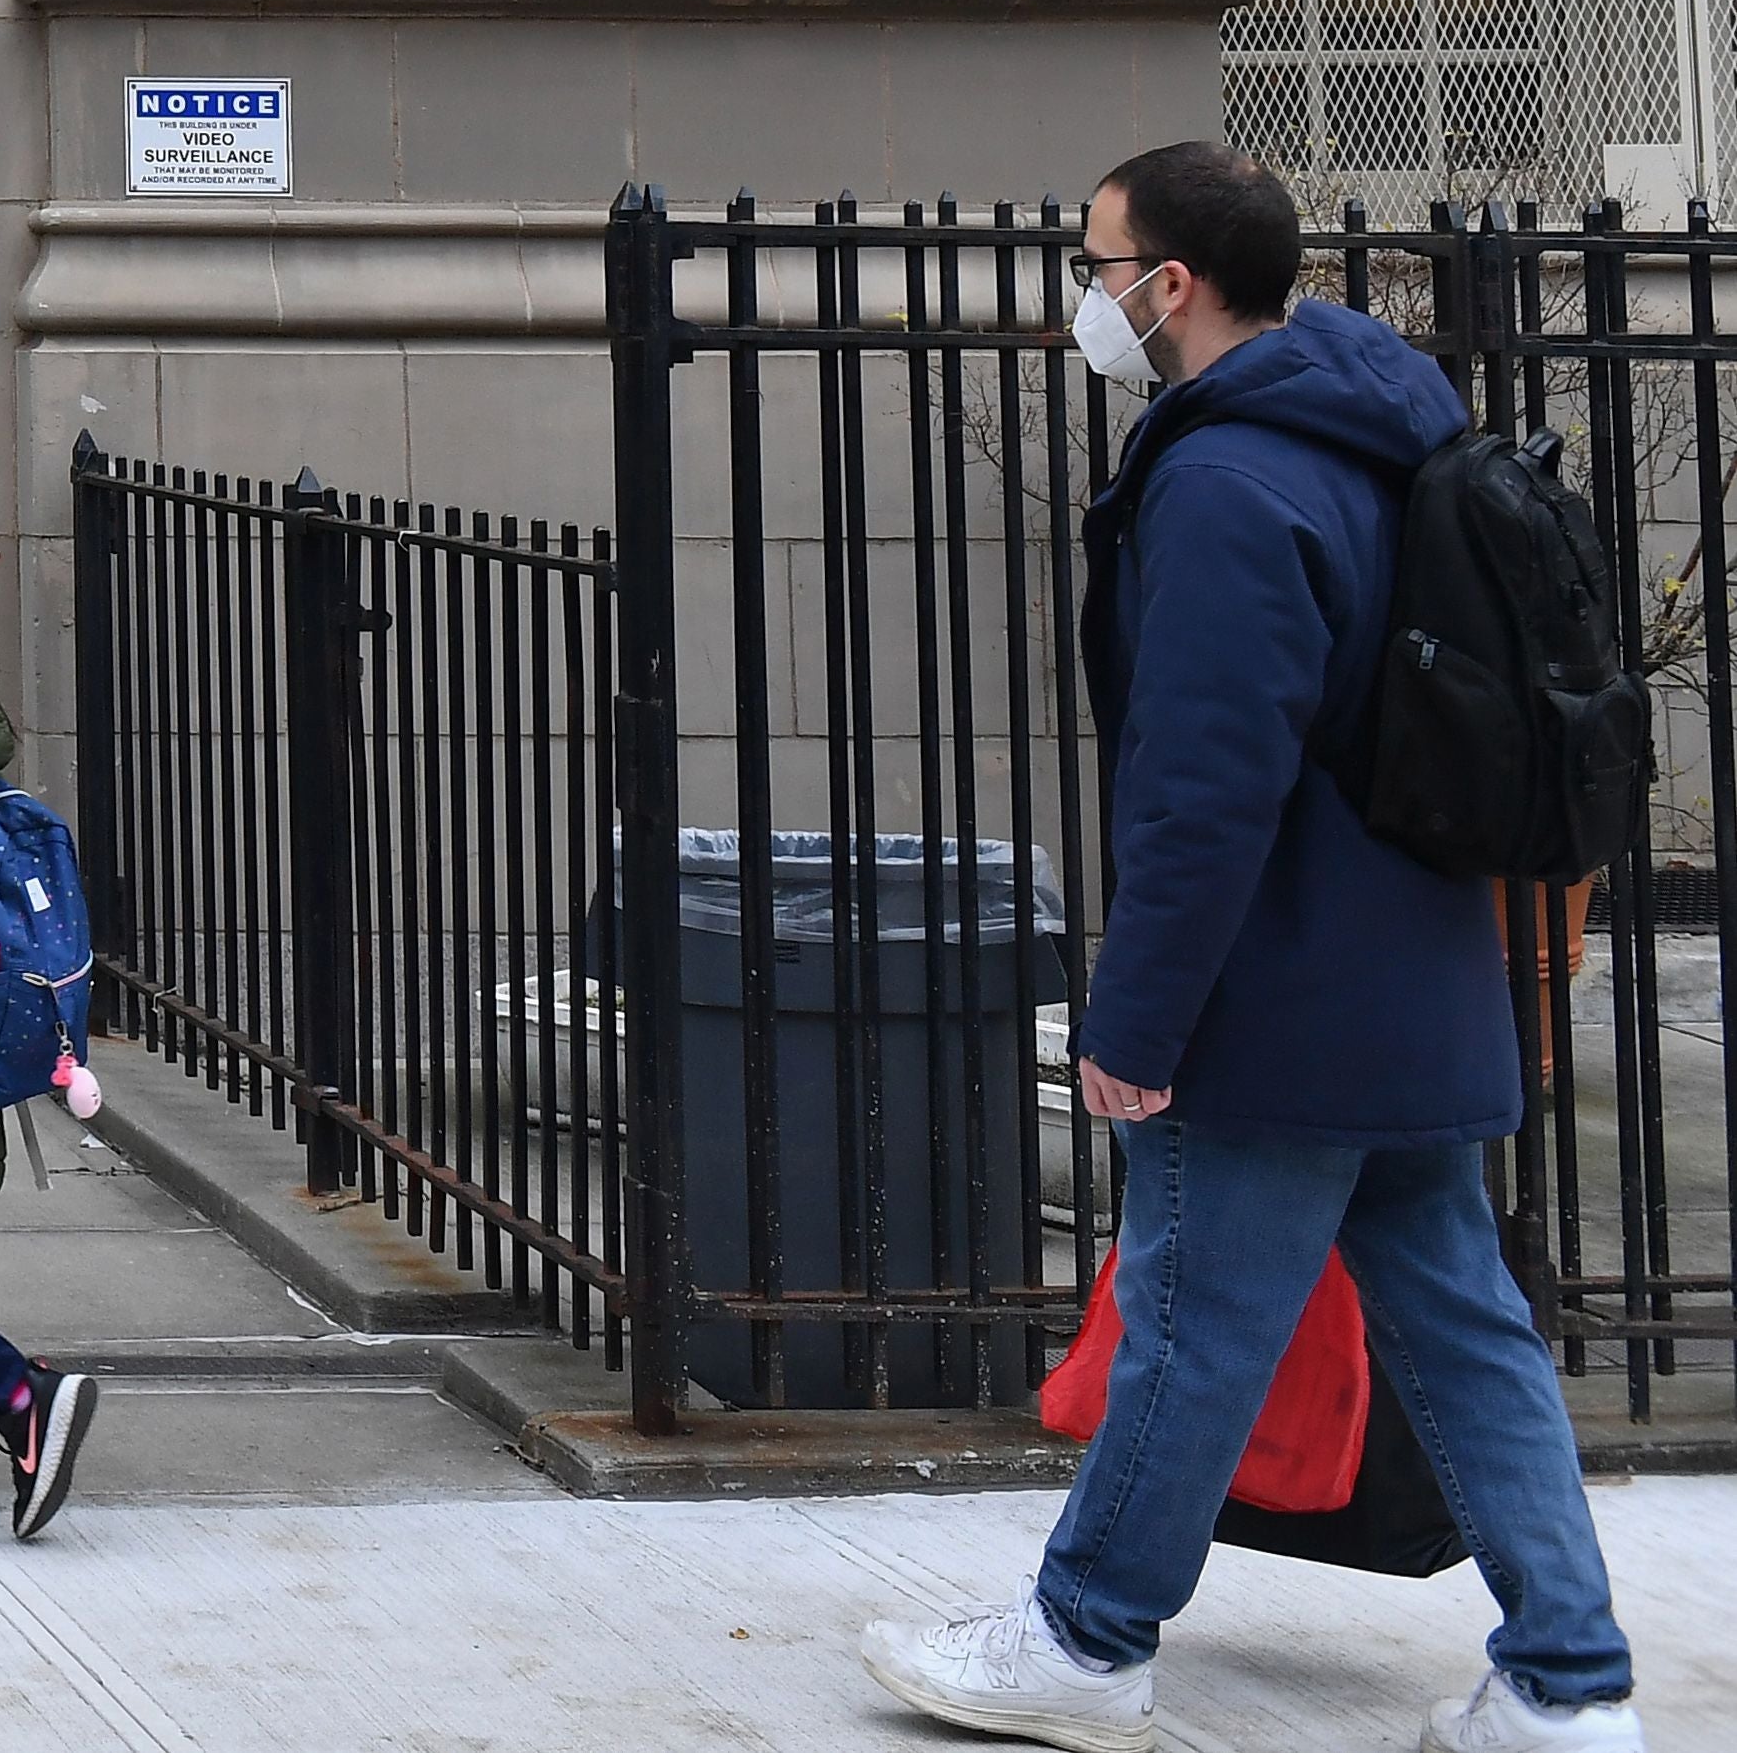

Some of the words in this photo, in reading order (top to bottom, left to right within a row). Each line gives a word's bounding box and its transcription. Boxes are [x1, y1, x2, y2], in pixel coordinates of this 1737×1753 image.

[141, 94, 275, 114] NOTICE
[183, 133, 234, 146] VIDEO
[144, 149, 274, 163] SURVEILLANCE
[213, 167, 264, 175] MONITORED
[177, 176, 223, 184] RECORDED
